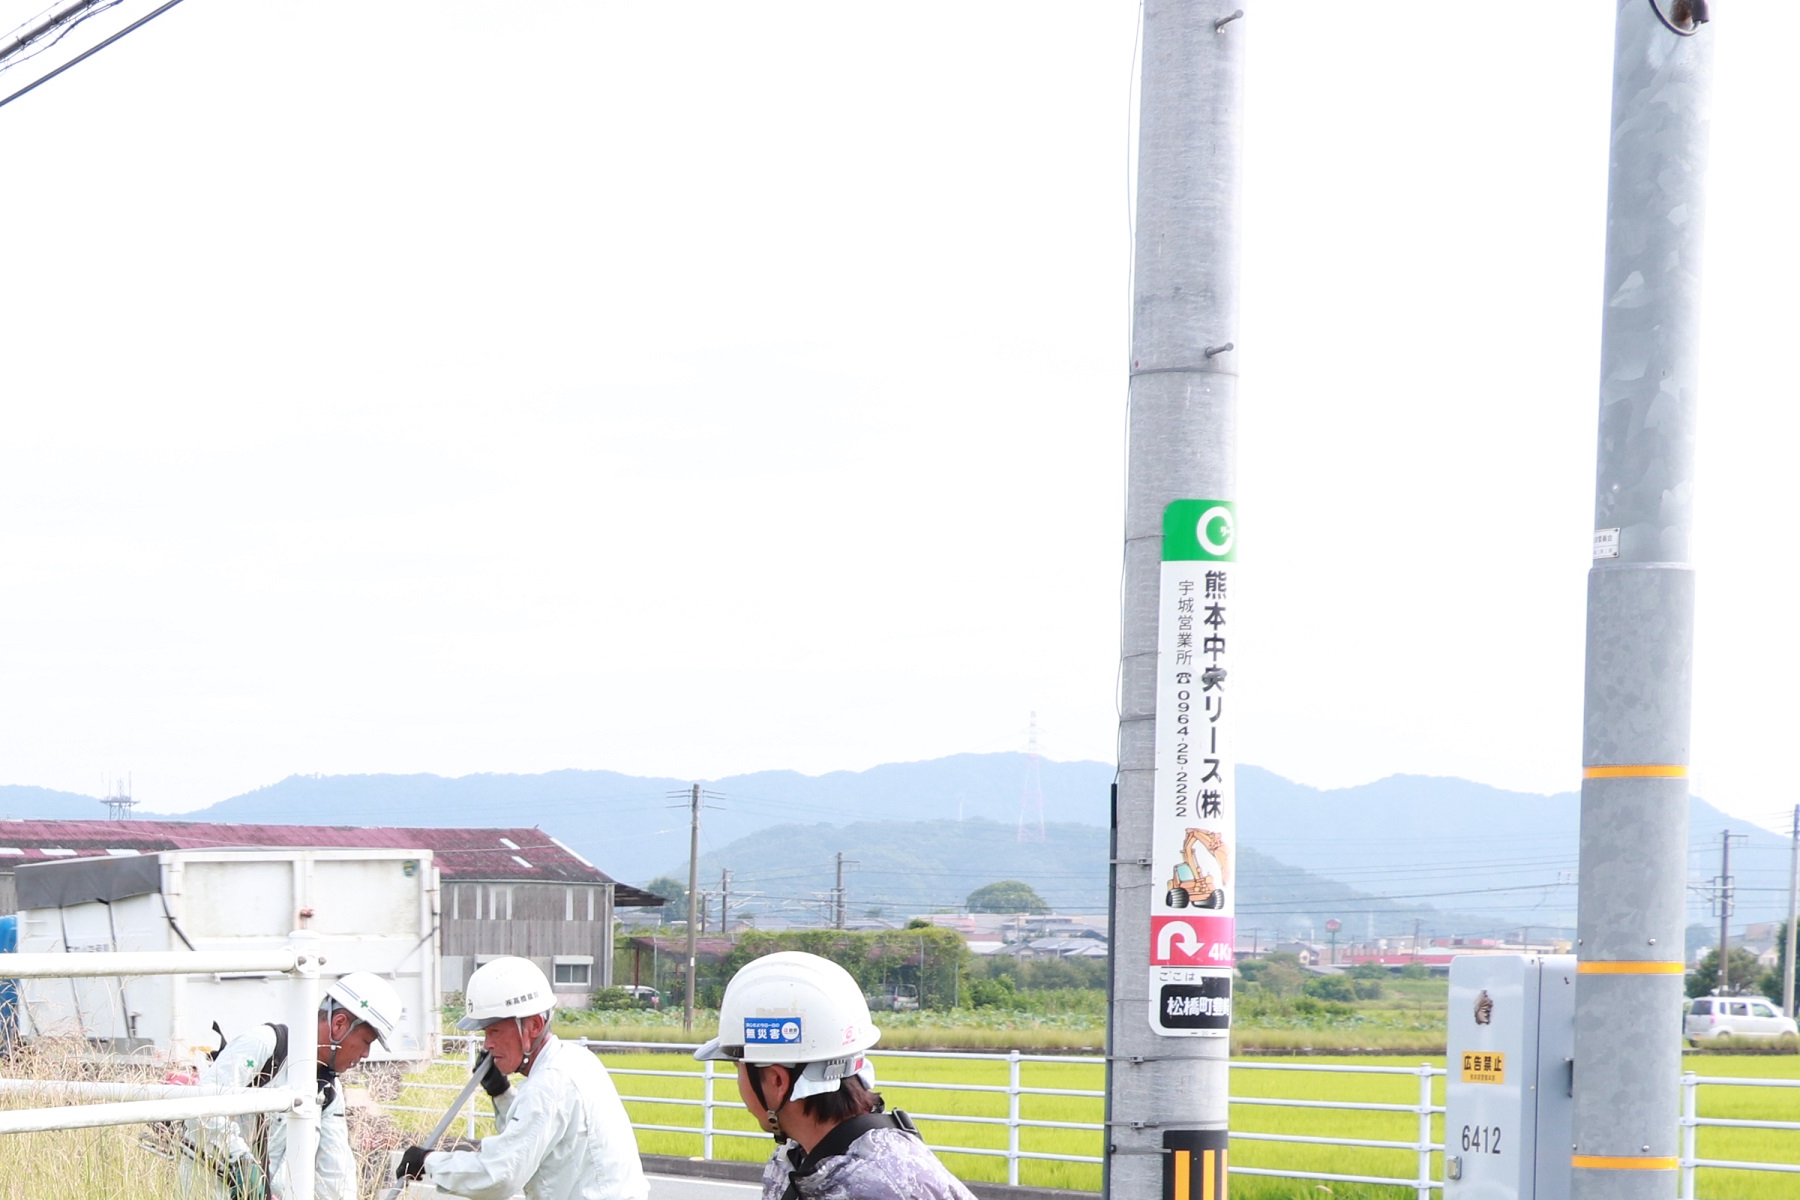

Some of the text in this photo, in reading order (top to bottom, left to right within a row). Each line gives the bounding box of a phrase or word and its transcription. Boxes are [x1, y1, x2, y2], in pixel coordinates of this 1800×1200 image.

[1175, 580, 1194, 818] 宇城営業所 0964-25-2222
[1166, 996, 1230, 1016] 松橋町豊
[1463, 1055, 1503, 1072] 広告禁止
[1461, 1125, 1502, 1155] 6412
